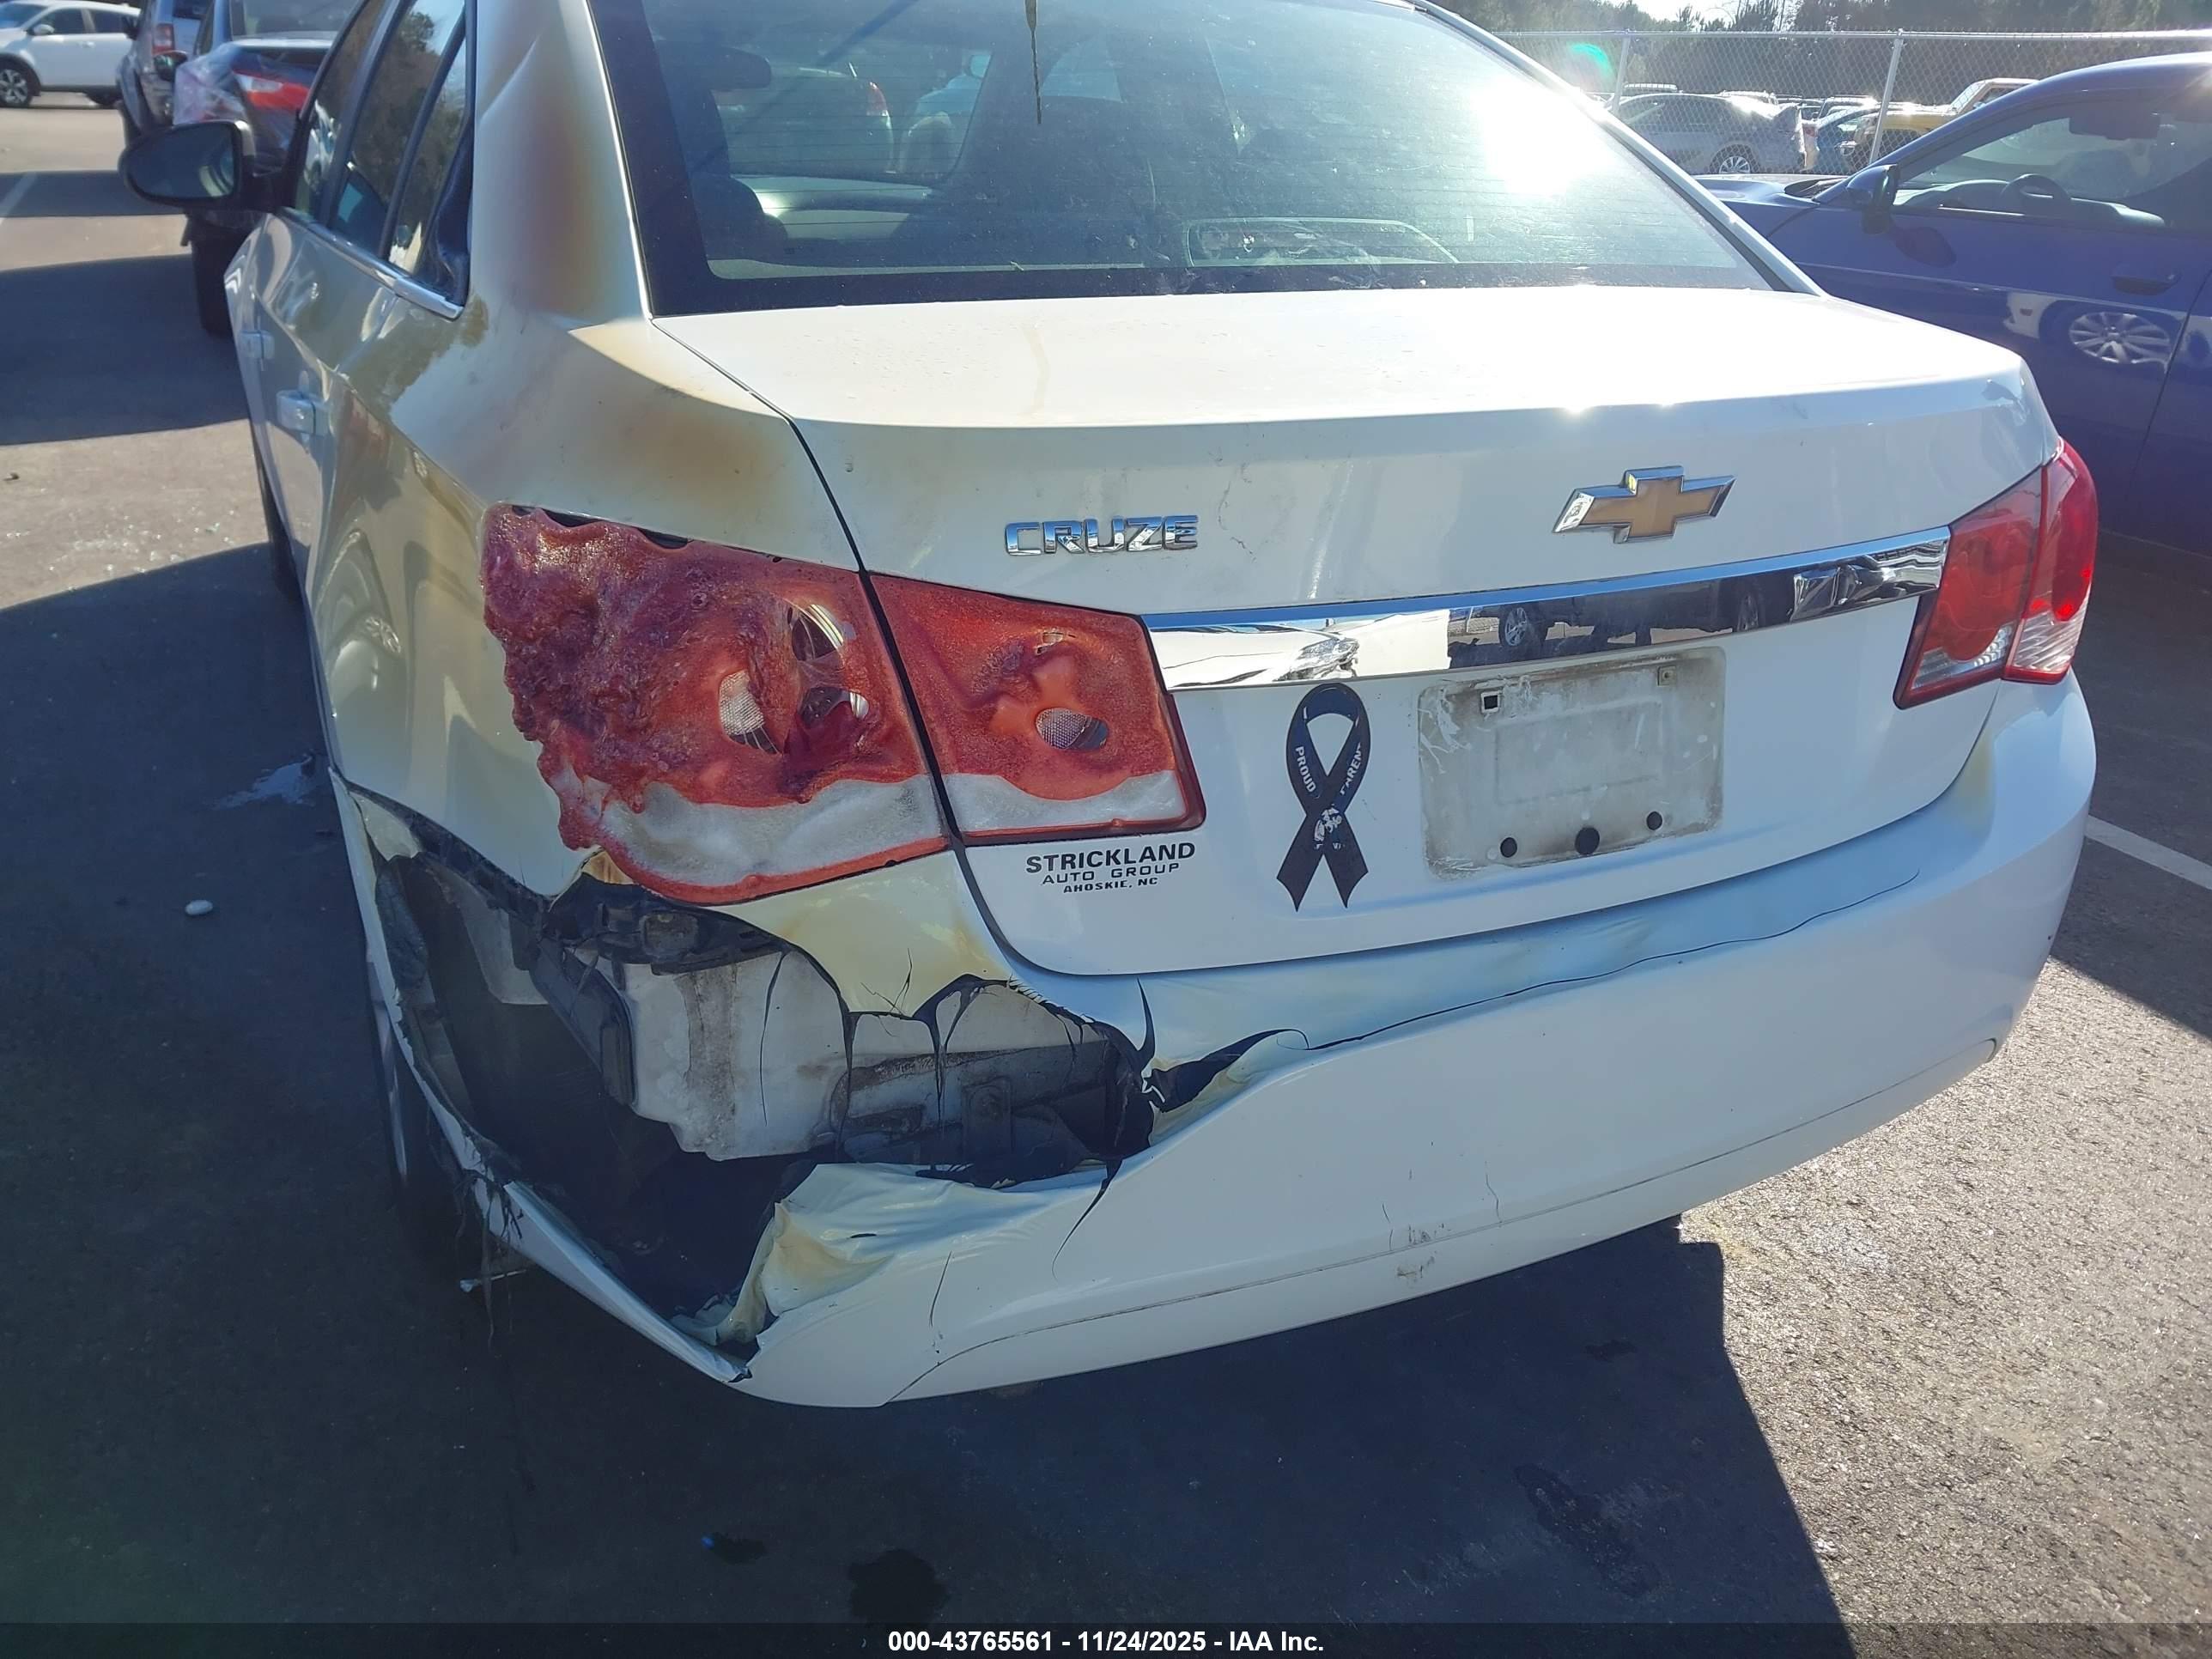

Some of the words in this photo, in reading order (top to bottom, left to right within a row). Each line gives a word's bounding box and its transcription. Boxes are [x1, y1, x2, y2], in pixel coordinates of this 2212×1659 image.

[1005, 515, 1199, 556] CRUZE
[1296, 746, 1316, 793] PROUD
[1026, 842, 1195, 873] STRICKLAND
[1041, 871, 1095, 886] AUTO
[1111, 862, 1180, 878] GROUP
[1063, 878, 1133, 893] AHOSKIE,
[1138, 877, 1158, 886] NC
